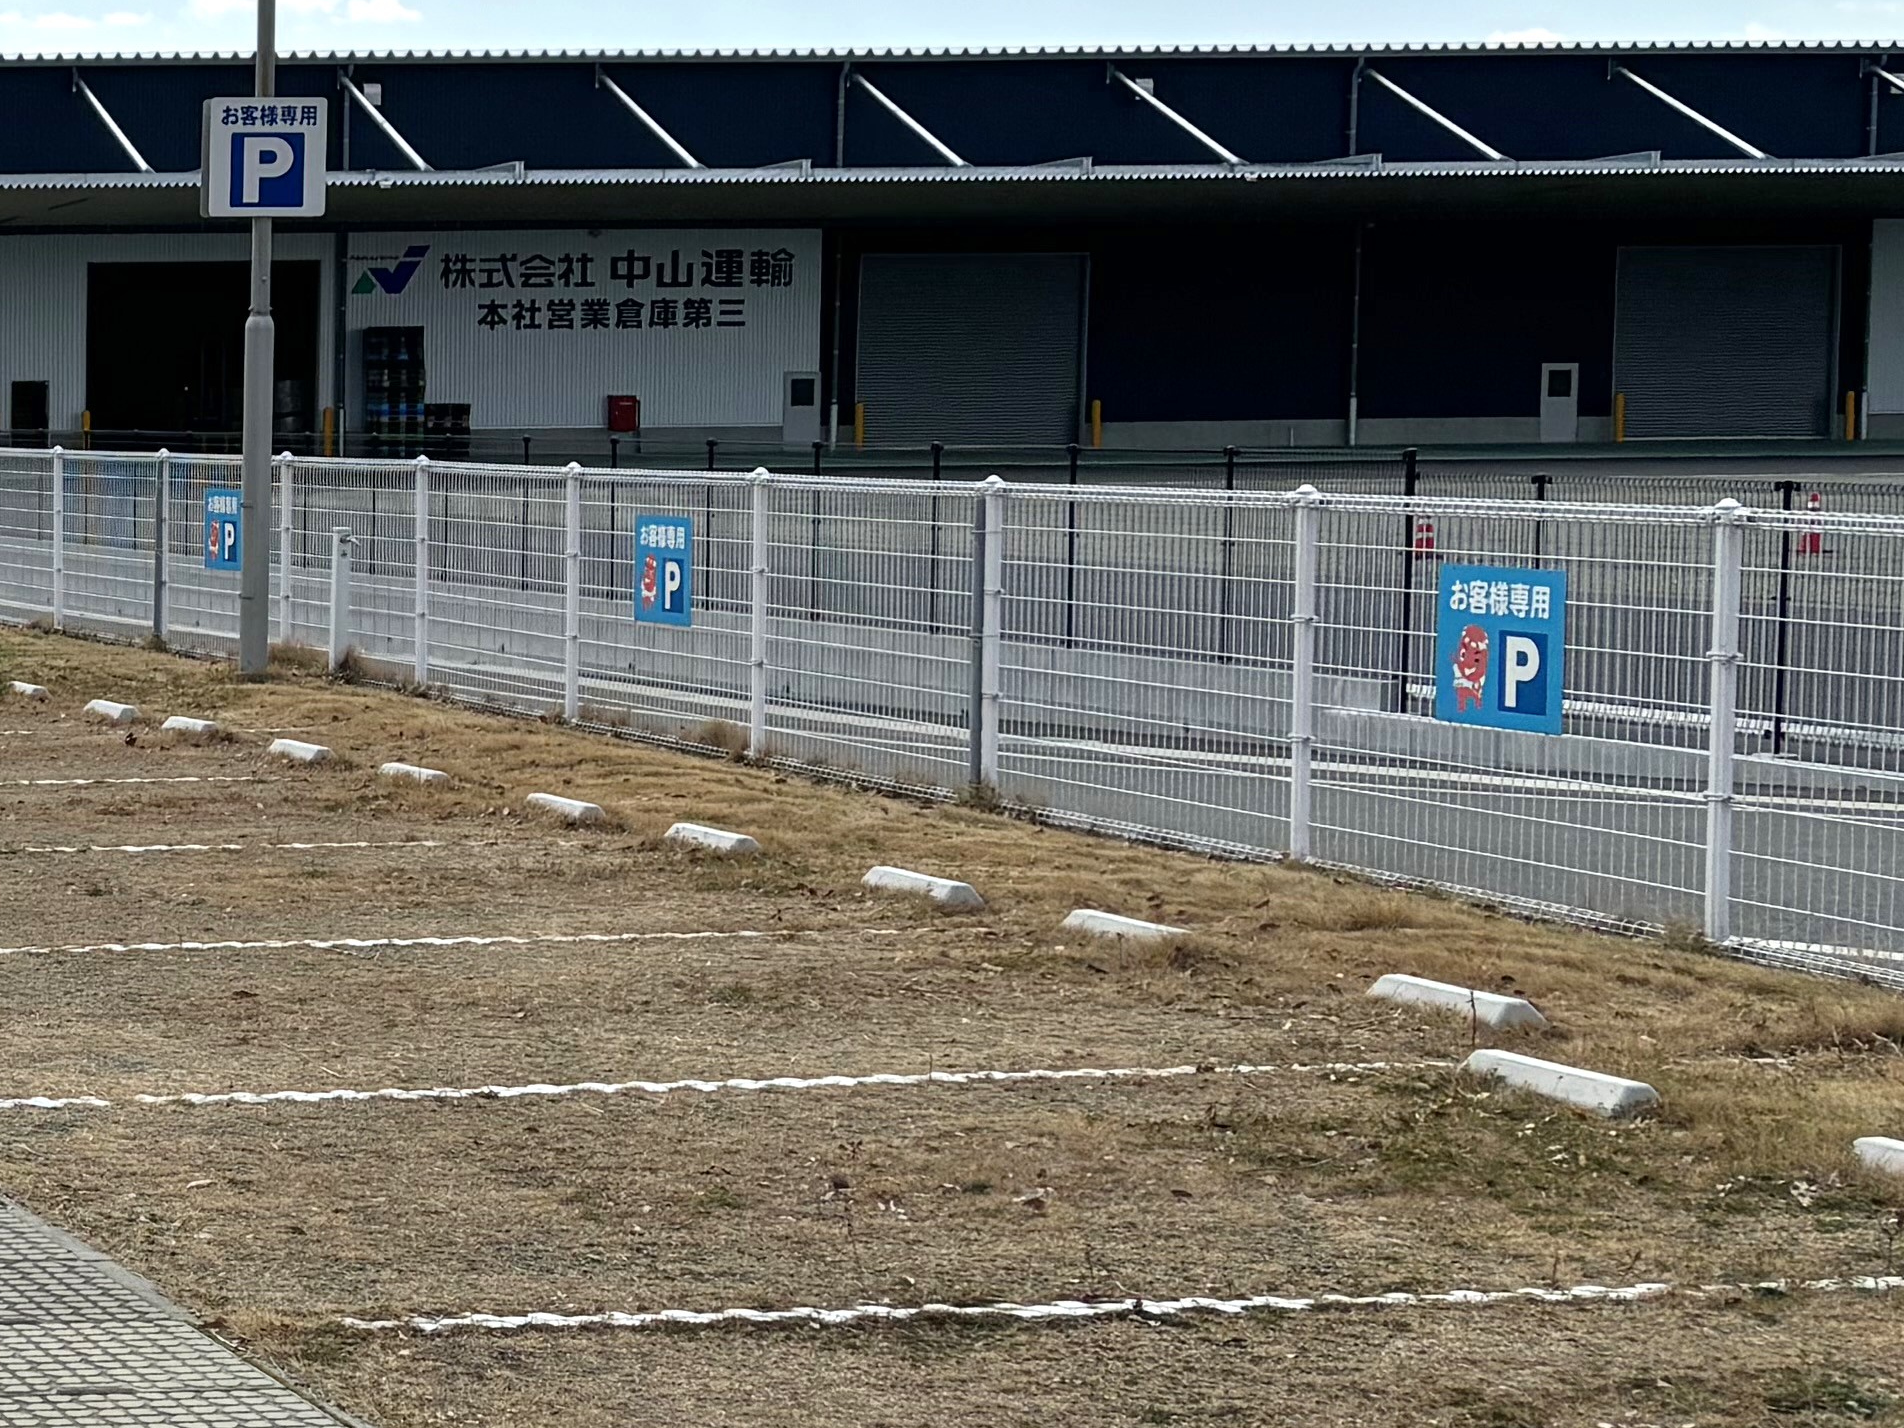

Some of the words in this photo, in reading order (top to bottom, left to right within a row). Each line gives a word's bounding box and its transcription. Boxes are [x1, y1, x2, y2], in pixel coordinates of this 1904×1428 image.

[221, 105, 318, 127] お客様専用
[242, 136, 294, 204] P
[439, 253, 596, 289] 株式会社
[609, 248, 797, 289] 中山運輸
[478, 298, 747, 330] 本社営業倉庫第三
[224, 522, 235, 560] P
[639, 524, 686, 550] お客様専用
[664, 561, 681, 610] P
[1449, 580, 1551, 619] お客様専用
[1504, 635, 1540, 708] P
